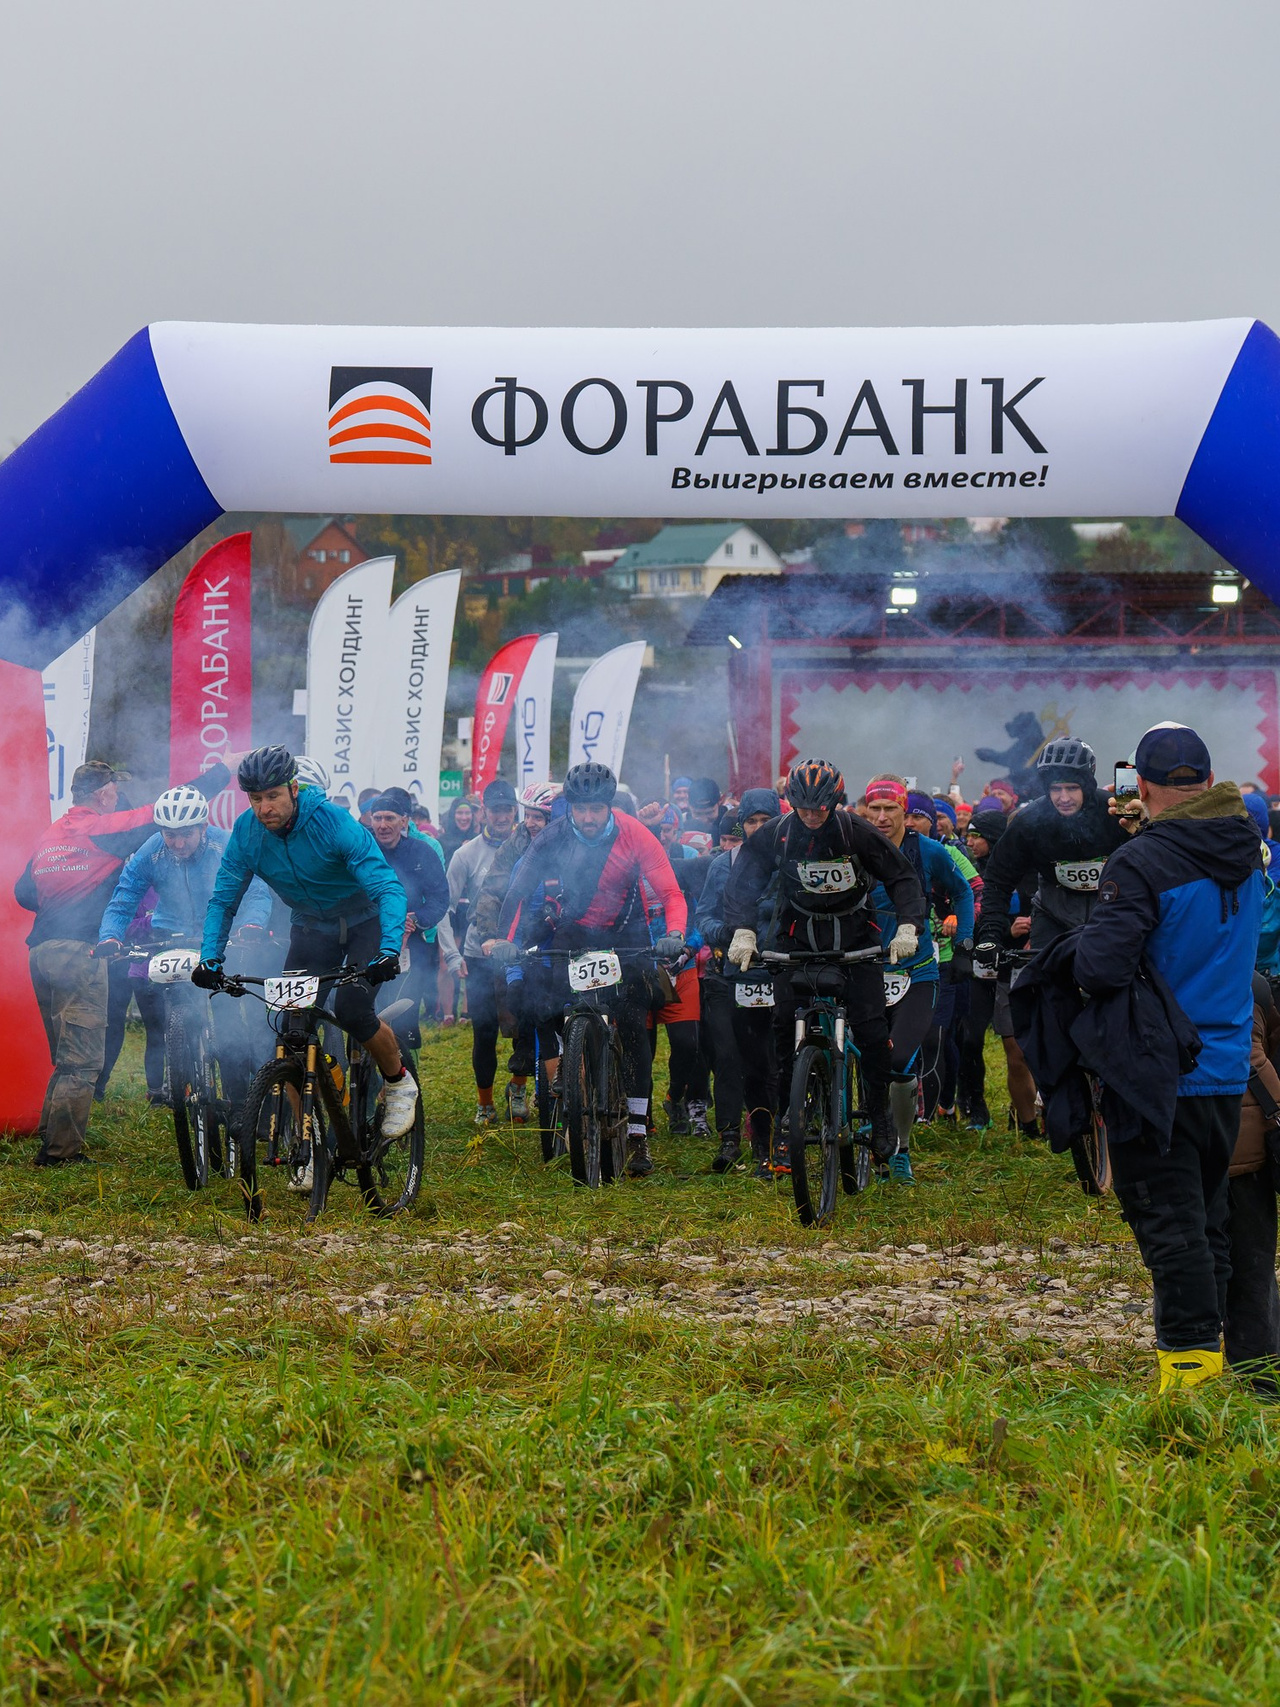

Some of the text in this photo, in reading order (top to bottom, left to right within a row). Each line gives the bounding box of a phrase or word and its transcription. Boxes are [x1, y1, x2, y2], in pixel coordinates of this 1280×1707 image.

[471, 376, 1049, 456] ФОРАБАНК
[671, 465, 1049, 494] Выигрываем вместе!
[334, 594, 363, 774] БАЗИС ХОЛДИНГ
[403, 604, 430, 773] БАЗИС ХОЛДИНГ
[809, 869, 843, 884] 570
[1067, 868, 1100, 882] 569
[159, 957, 193, 974] 574
[578, 959, 610, 980] 575
[275, 980, 305, 999] 115
[744, 983, 774, 997] 543
